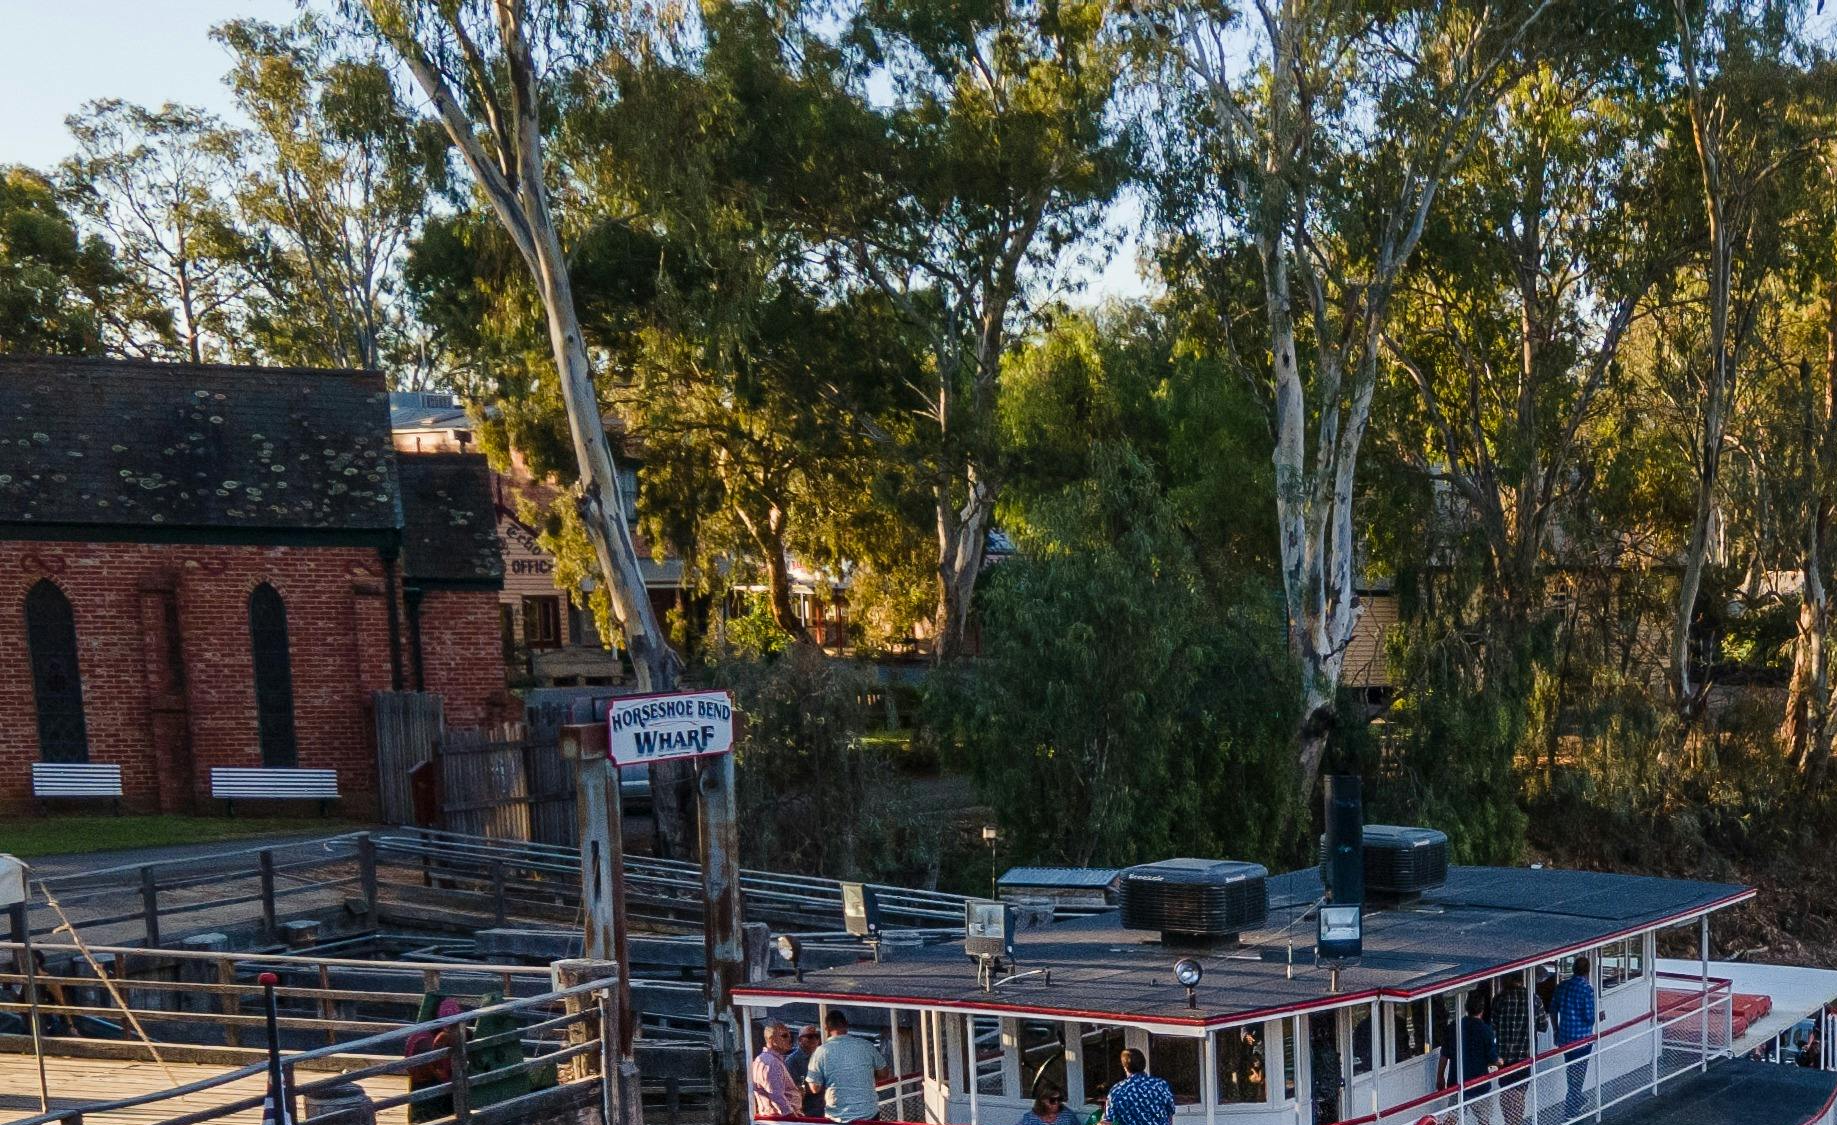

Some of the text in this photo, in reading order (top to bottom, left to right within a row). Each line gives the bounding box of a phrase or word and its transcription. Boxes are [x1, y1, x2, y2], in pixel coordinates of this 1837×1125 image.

[512, 560, 554, 574] OFFIC
[612, 700, 731, 732] HORSESHOE BEND
[634, 725, 715, 755] WHARF
